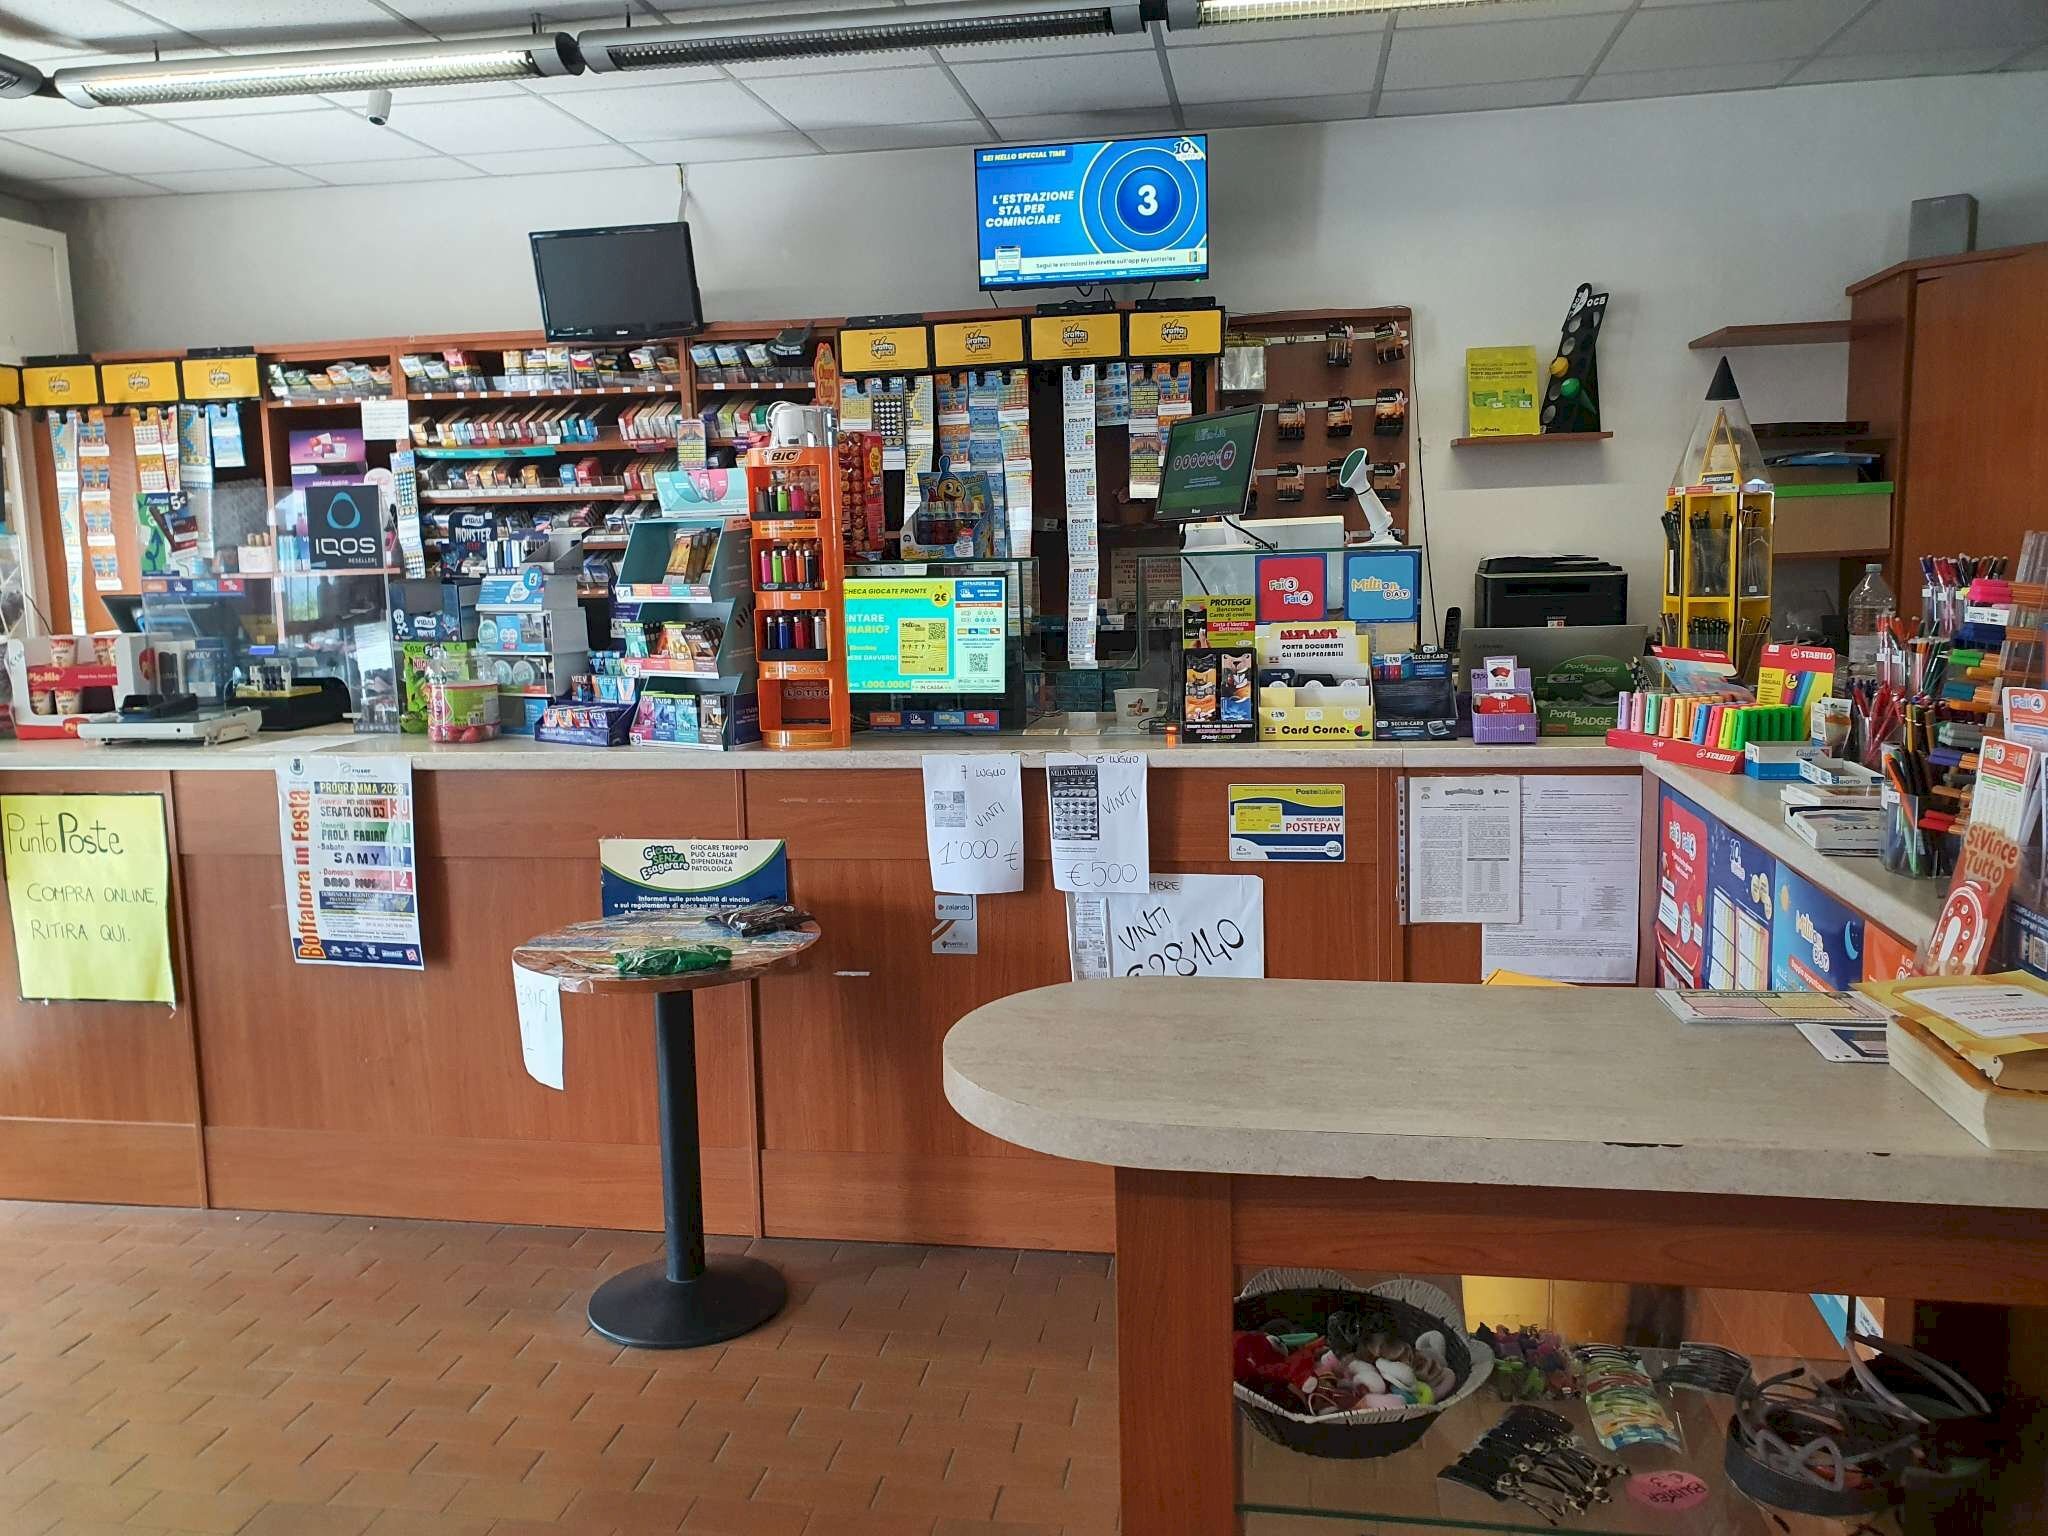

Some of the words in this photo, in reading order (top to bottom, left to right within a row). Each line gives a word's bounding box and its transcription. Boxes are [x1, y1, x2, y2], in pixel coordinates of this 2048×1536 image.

[1017, 152, 1047, 160] SPECIAL
[1048, 150, 1066, 158] TIME
[1137, 184, 1159, 216] 3
[998, 205, 1021, 216] STA
[1024, 204, 1046, 214] PER
[985, 214, 1062, 228] COMINCIARE
[1586, 297, 1606, 307] OCB
[771, 450, 798, 462] BIC
[464, 516, 484, 526] VIDAL
[454, 528, 492, 544] MONSTER
[316, 538, 376, 556] IQOS
[1254, 541, 1279, 550] Sisal
[1352, 576, 1400, 592] Million
[934, 592, 948, 602] 2€
[1384, 591, 1410, 600] DAY
[1800, 651, 1832, 660] STABILO
[1550, 710, 1577, 720] Porta
[1574, 718, 1612, 726] BADGE
[1282, 726, 1309, 734] Card
[1706, 752, 1736, 762] STABILO
[320, 783, 378, 794] PROGRAMMA
[1102, 785, 1137, 815] VINTI
[288, 790, 310, 842] Festa
[320, 806, 352, 818] SERATA
[354, 807, 372, 818] CON
[373, 807, 384, 818] DJ
[974, 801, 1005, 828] VINTI
[1286, 822, 1340, 832] POSTEPAY
[334, 852, 380, 864] SAMY
[644, 844, 674, 860] Gioca
[652, 853, 686, 864] SENZA
[640, 862, 690, 880] Esagerare
[1965, 851, 2004, 884] Tutto
[27, 883, 94, 903] COMPRA
[104, 887, 158, 906] ONLINE,
[945, 904, 970, 912] zalando
[31, 919, 88, 941] RITIRA
[100, 924, 132, 943] QUI.
[1118, 906, 1171, 952] VINTI
